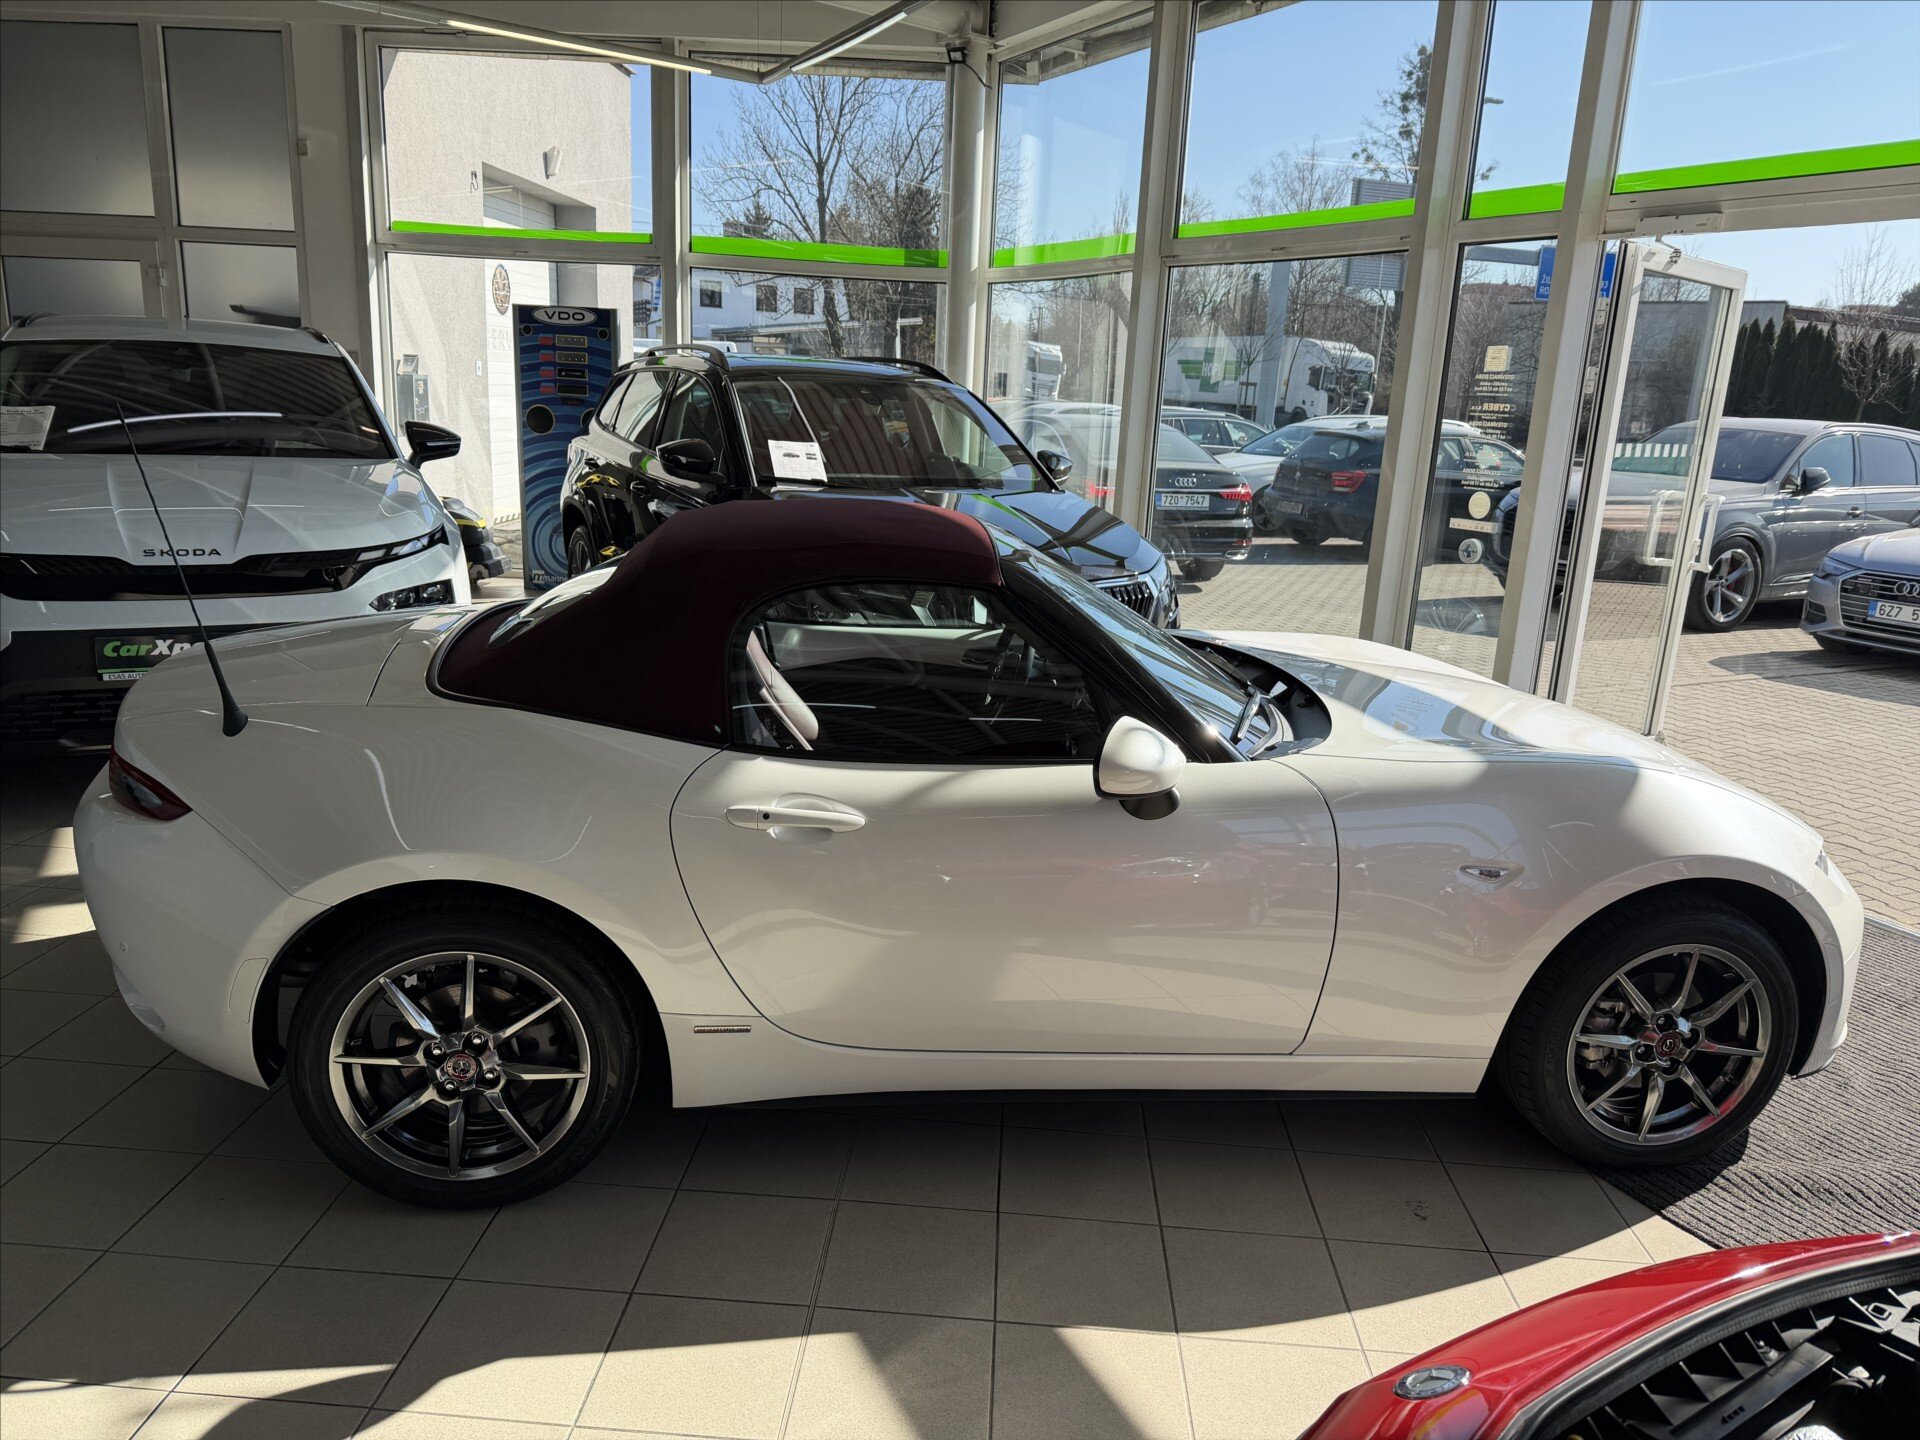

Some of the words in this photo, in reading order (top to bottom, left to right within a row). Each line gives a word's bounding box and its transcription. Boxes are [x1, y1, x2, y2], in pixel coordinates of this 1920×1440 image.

[544, 310, 585, 322] VDO
[1163, 495, 1179, 506] 7Z0
[1185, 495, 1206, 506] 7547
[1879, 603, 1903, 618] 6Z7
[1911, 609, 1920, 621] 5
